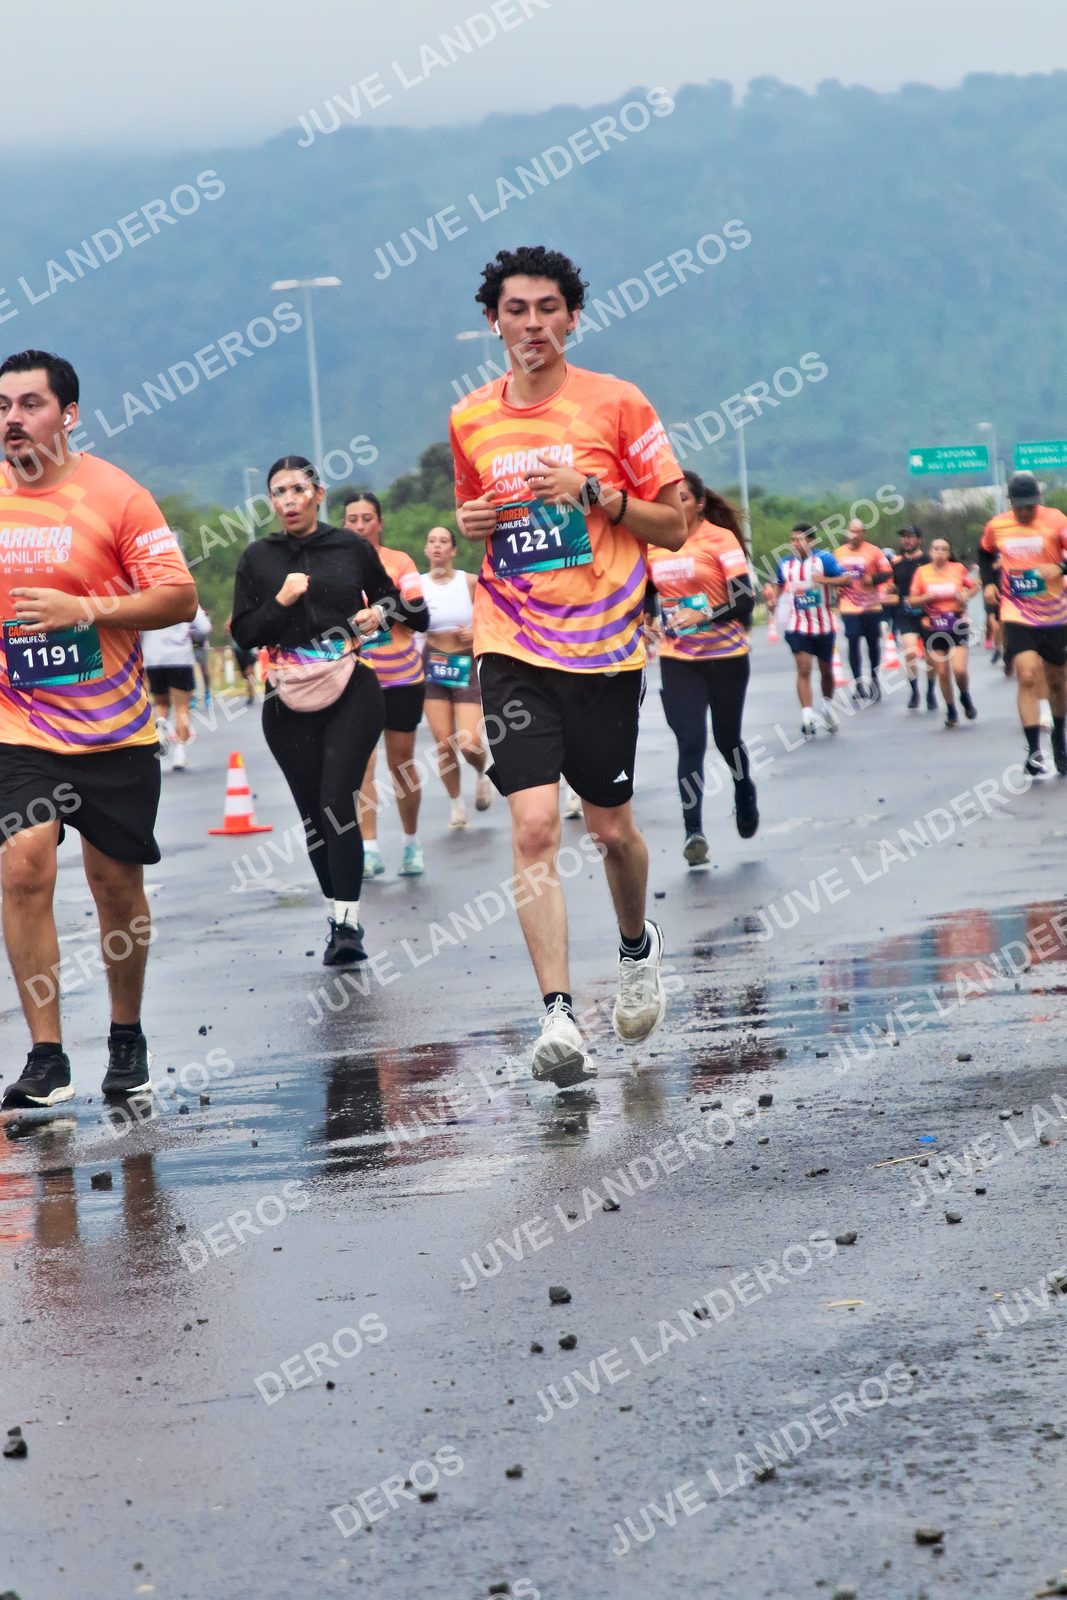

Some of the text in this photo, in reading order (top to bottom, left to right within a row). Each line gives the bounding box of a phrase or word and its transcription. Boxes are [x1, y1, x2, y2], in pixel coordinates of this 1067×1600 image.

[492, 443, 574, 478] CARRERA
[506, 526, 562, 555] 1221
[8, 635, 38, 645] OMNILIFE
[22, 643, 80, 668] 1191
